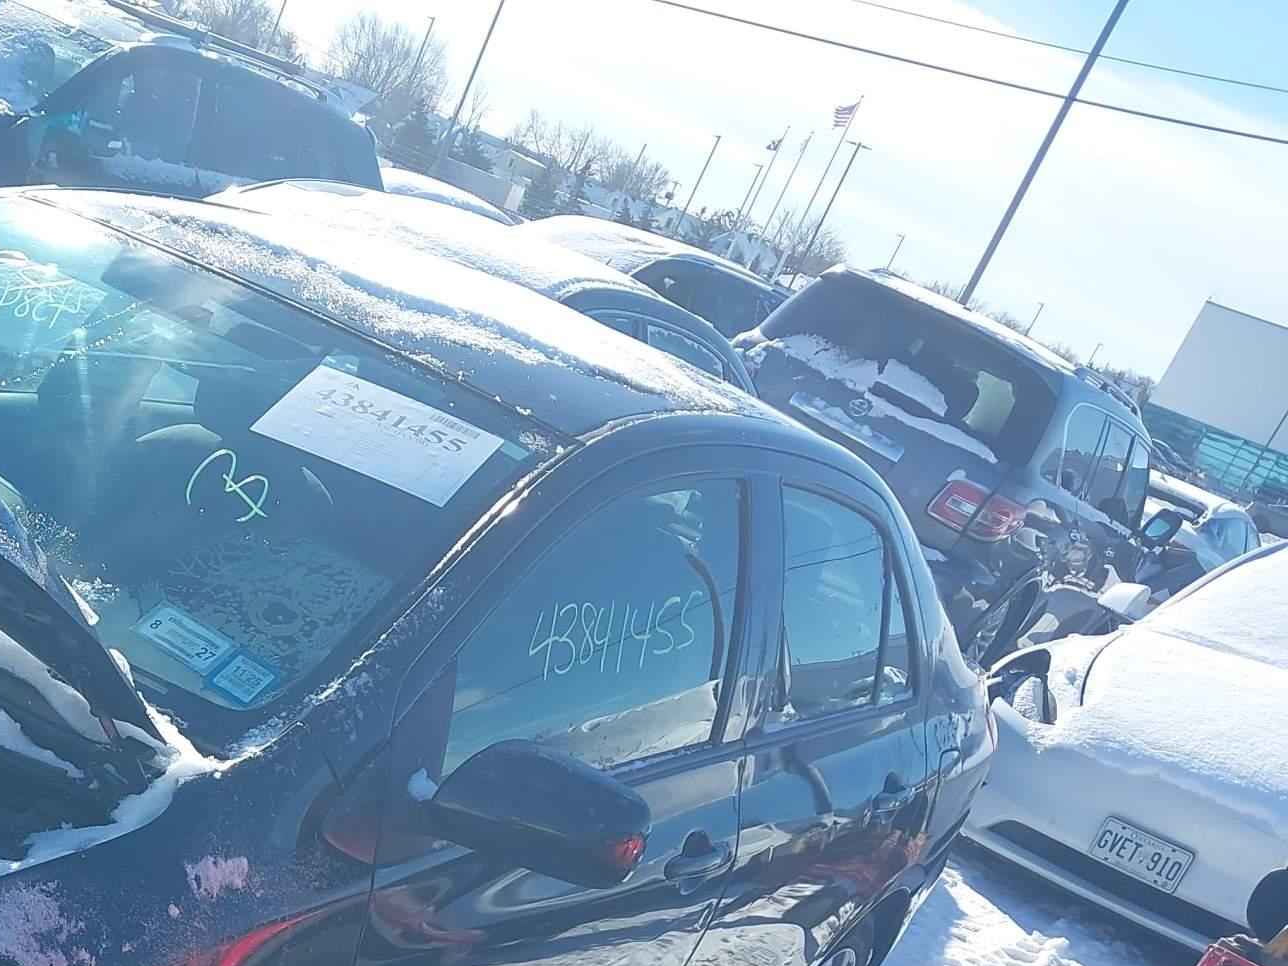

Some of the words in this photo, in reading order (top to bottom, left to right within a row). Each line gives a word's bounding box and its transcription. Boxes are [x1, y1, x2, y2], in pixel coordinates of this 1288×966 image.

[316, 386, 468, 455] 43841455
[196, 646, 217, 661] 27
[528, 591, 703, 681] 43841455
[1097, 829, 1144, 862] GVET
[1146, 851, 1183, 881] 910
